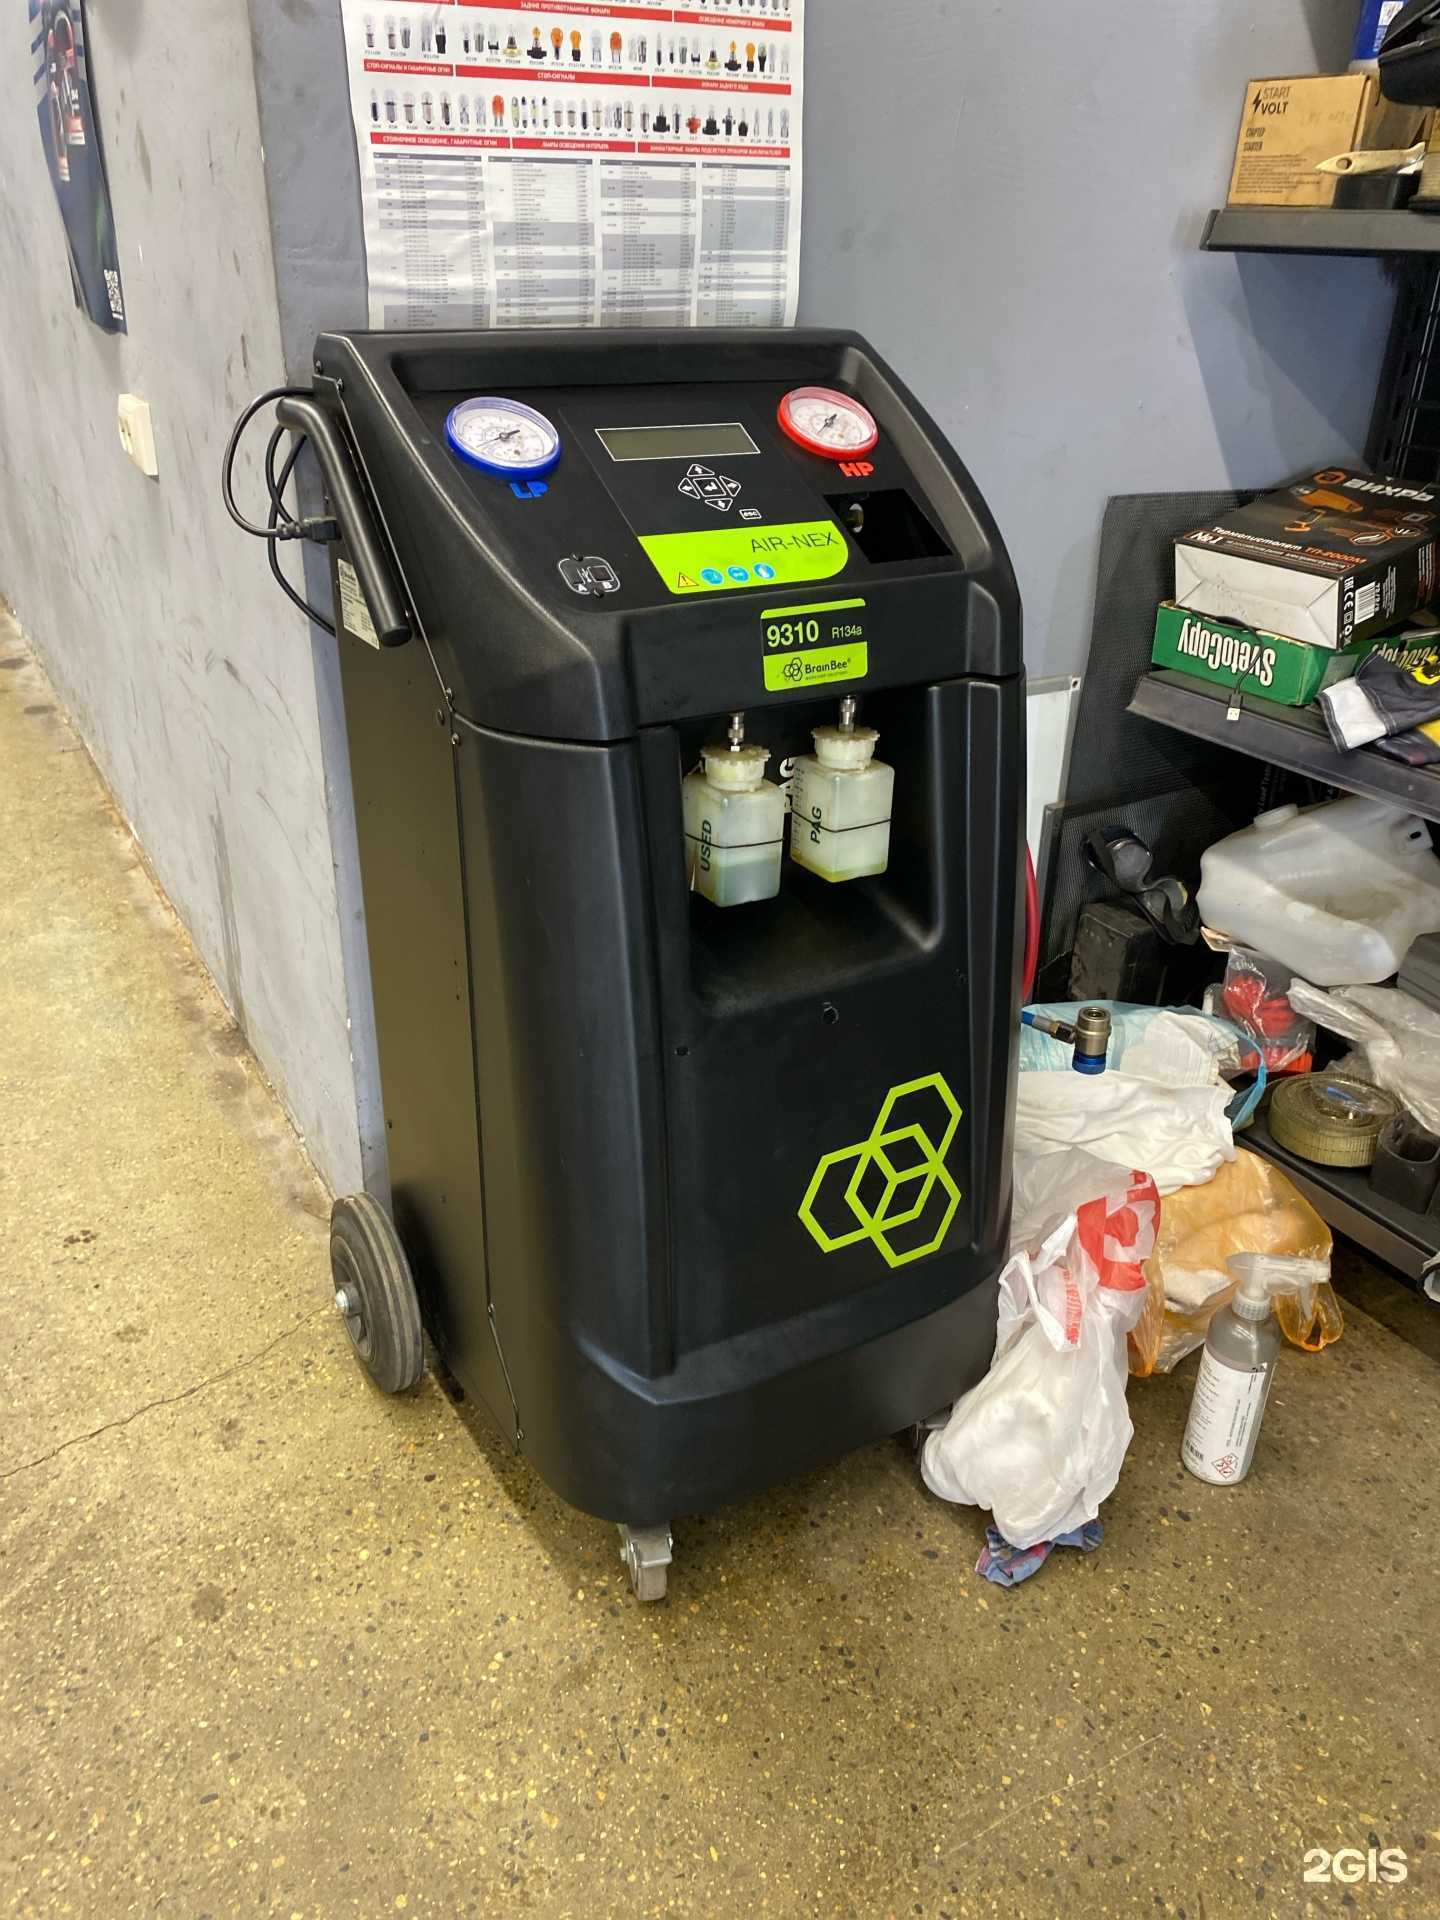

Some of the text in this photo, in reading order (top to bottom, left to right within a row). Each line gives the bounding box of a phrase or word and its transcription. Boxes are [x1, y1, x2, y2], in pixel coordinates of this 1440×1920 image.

[1263, 86, 1291, 99] START
[1261, 102, 1289, 115] VOLT
[838, 461, 874, 477] HP
[510, 480, 549, 498] LP
[751, 532, 840, 553] AIR-NEX
[766, 619, 863, 648] 9310 R134a
[1177, 617, 1276, 687] SvetoCopy
[810, 806, 822, 845] PAG
[699, 819, 712, 873] USED
